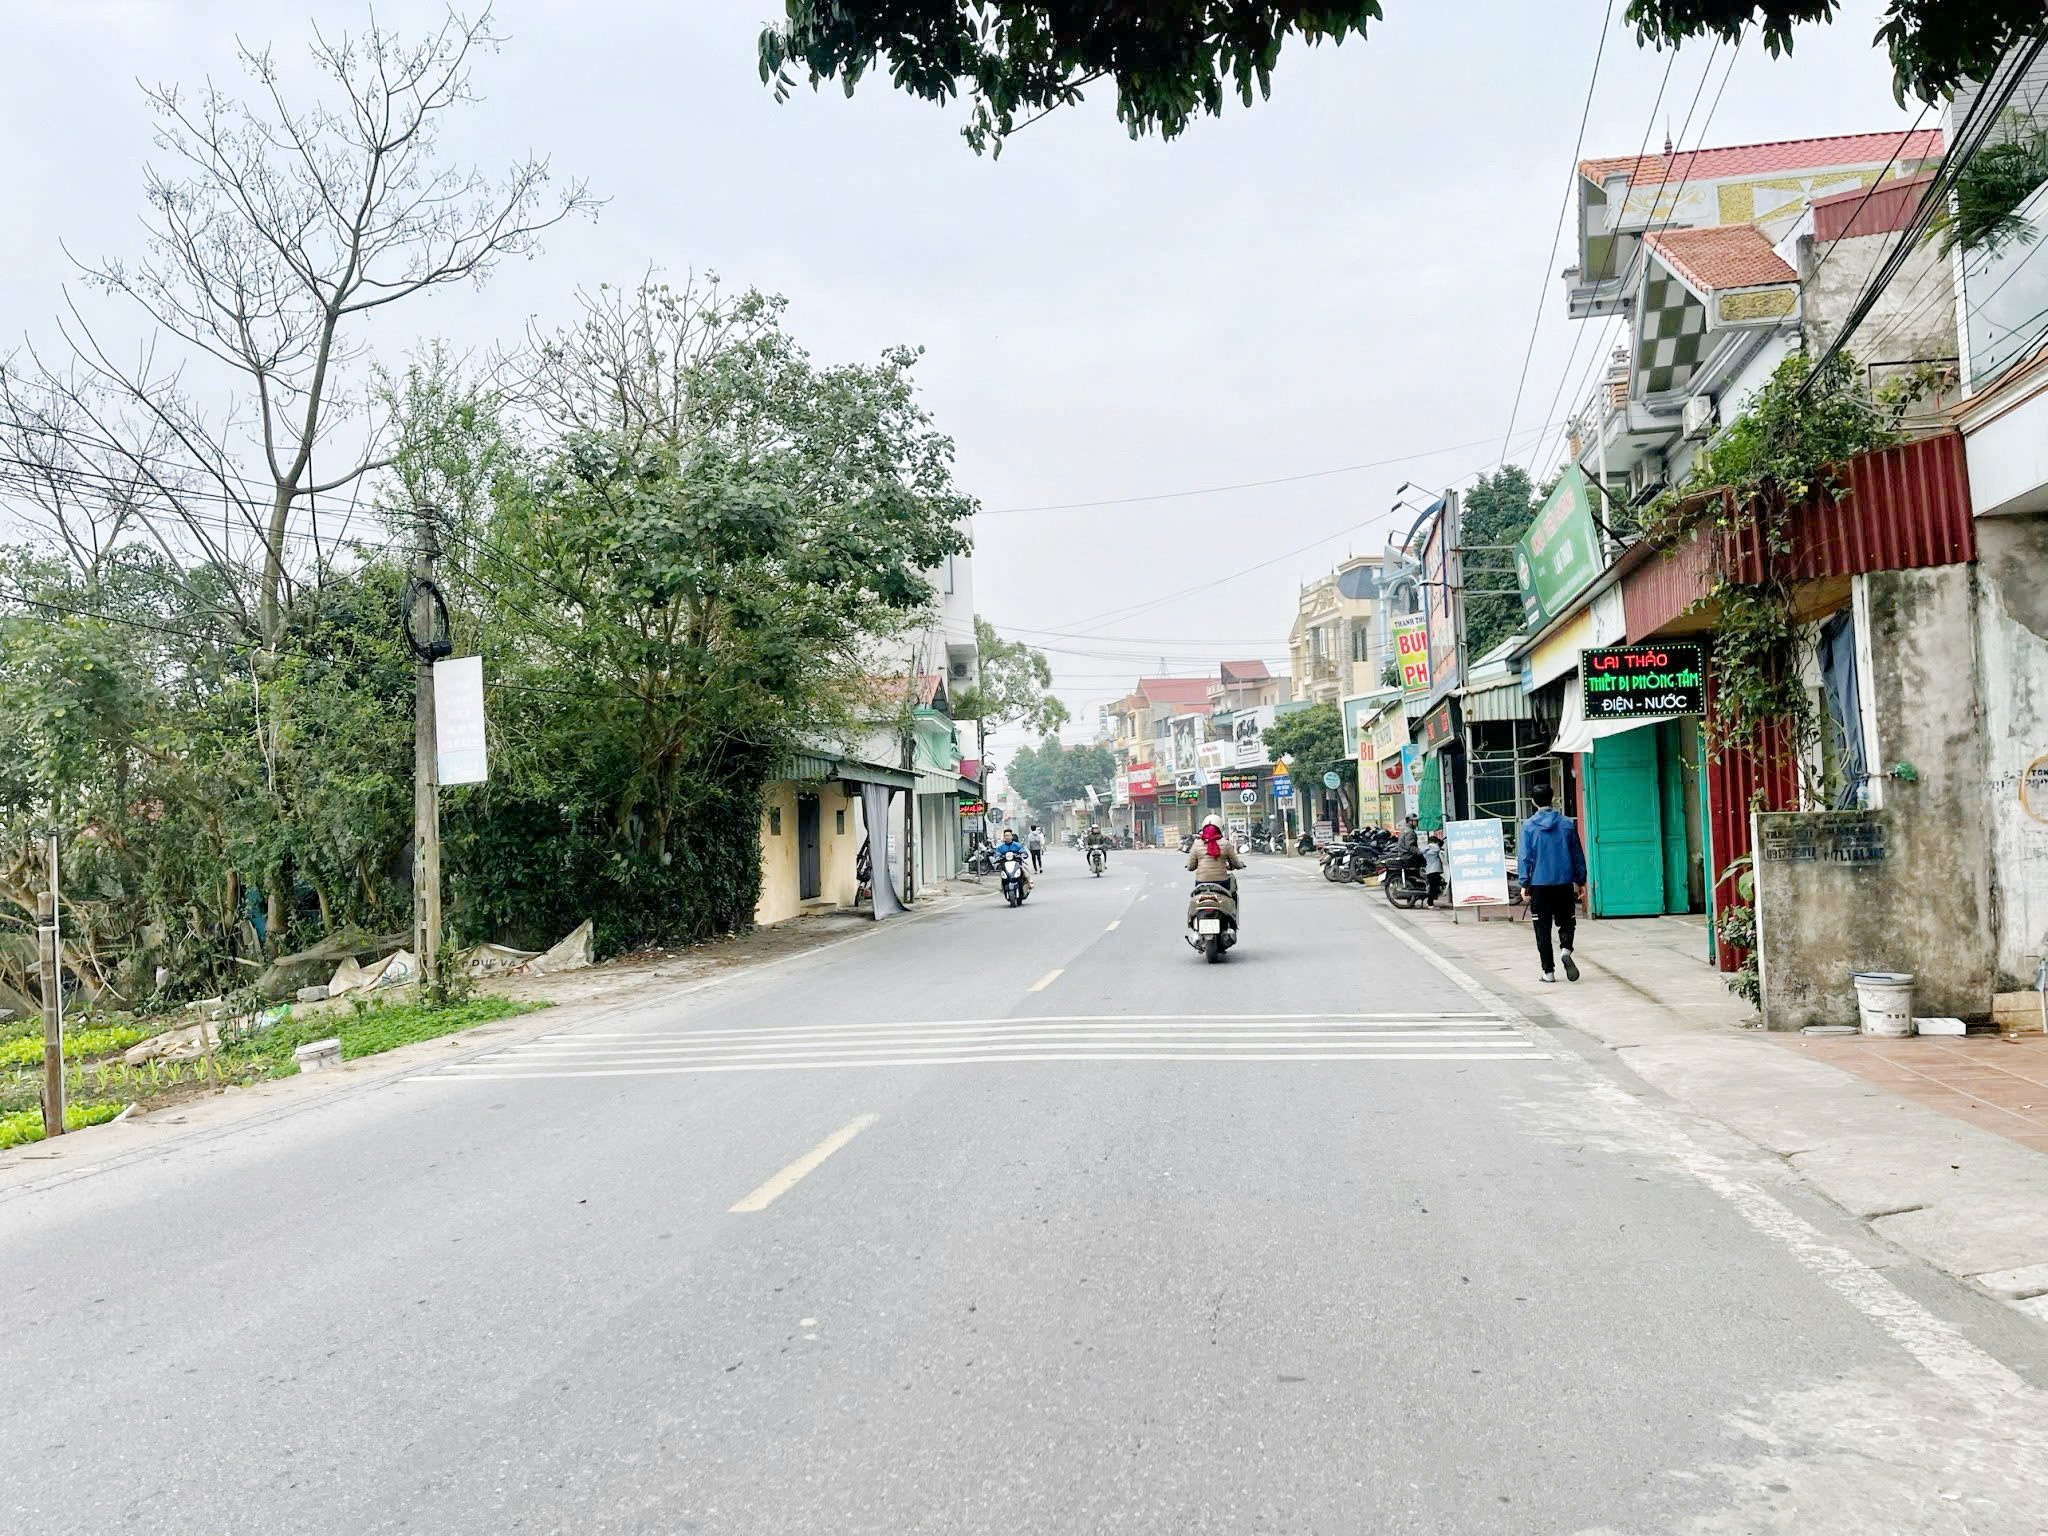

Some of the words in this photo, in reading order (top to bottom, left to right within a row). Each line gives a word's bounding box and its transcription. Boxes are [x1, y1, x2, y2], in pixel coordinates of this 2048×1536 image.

[1594, 656, 1619, 669] LAI
[1624, 651, 1668, 669] THẢO
[1619, 676, 1630, 692] BỊ
[1632, 671, 1674, 689] PHÒNG
[1601, 696, 1633, 712] ĐIỆN
[1645, 693, 1687, 709] NƯỚC
